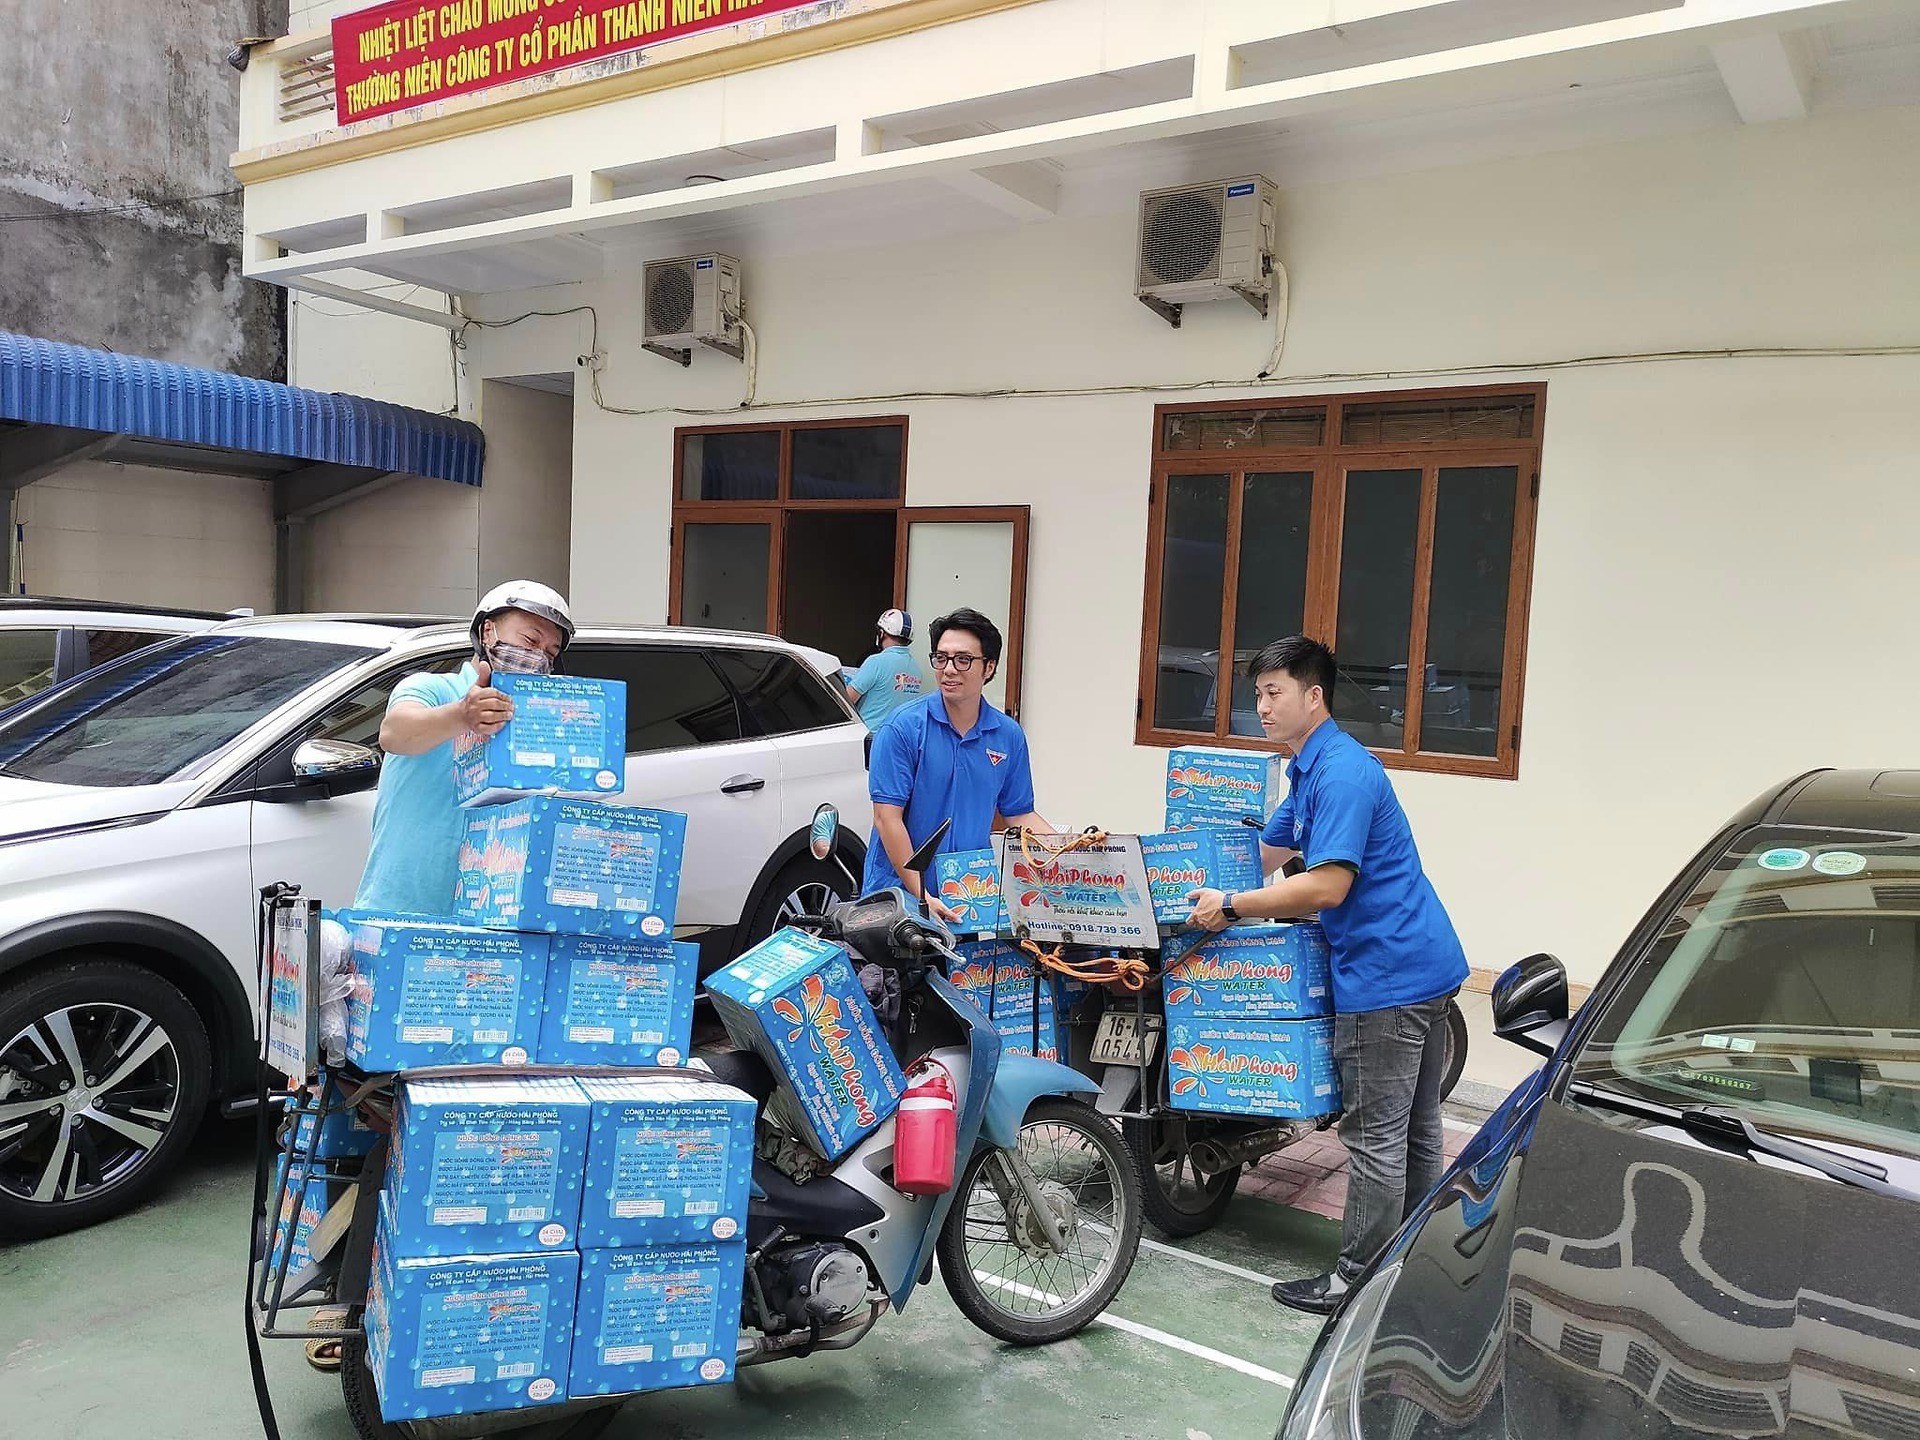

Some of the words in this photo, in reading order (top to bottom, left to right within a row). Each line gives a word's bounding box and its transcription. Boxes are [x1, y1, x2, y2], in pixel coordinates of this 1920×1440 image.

[359, 18, 400, 63] NHIỆT
[405, 7, 435, 51] LIỆT
[346, 67, 400, 114] THƯỜNG
[405, 56, 441, 97] NIÊN
[446, 45, 490, 86] CÔNG
[495, 37, 515, 73] TY
[519, 16, 543, 66] CỔ
[548, 6, 597, 58] PHẦN
[603, 0, 665, 44] THANH
[1192, 773, 1261, 794] HaiPhong
[1211, 787, 1243, 796] WATER
[1041, 867, 1125, 890] HaiPhong
[1147, 866, 1206, 886] Phong
[1066, 892, 1107, 902] WATER
[1152, 886, 1181, 896] ATER
[1028, 921, 1066, 932] Hotline:
[1069, 924, 1117, 934] 0918.739
[1120, 926, 1141, 935] 366
[1194, 960, 1292, 984] HaiPhong
[997, 982, 1030, 993] WATER
[1223, 981, 1266, 990] WATER
[816, 1015, 877, 1127] HaiPhong
[1201, 1053, 1298, 1082] HaiPhong
[818, 1056, 849, 1107] WATER
[1229, 1076, 1272, 1086] WATER
[613, 1254, 633, 1262] CÔNG
[430, 1271, 451, 1280] CÔNG
[454, 1270, 463, 1278] TY
